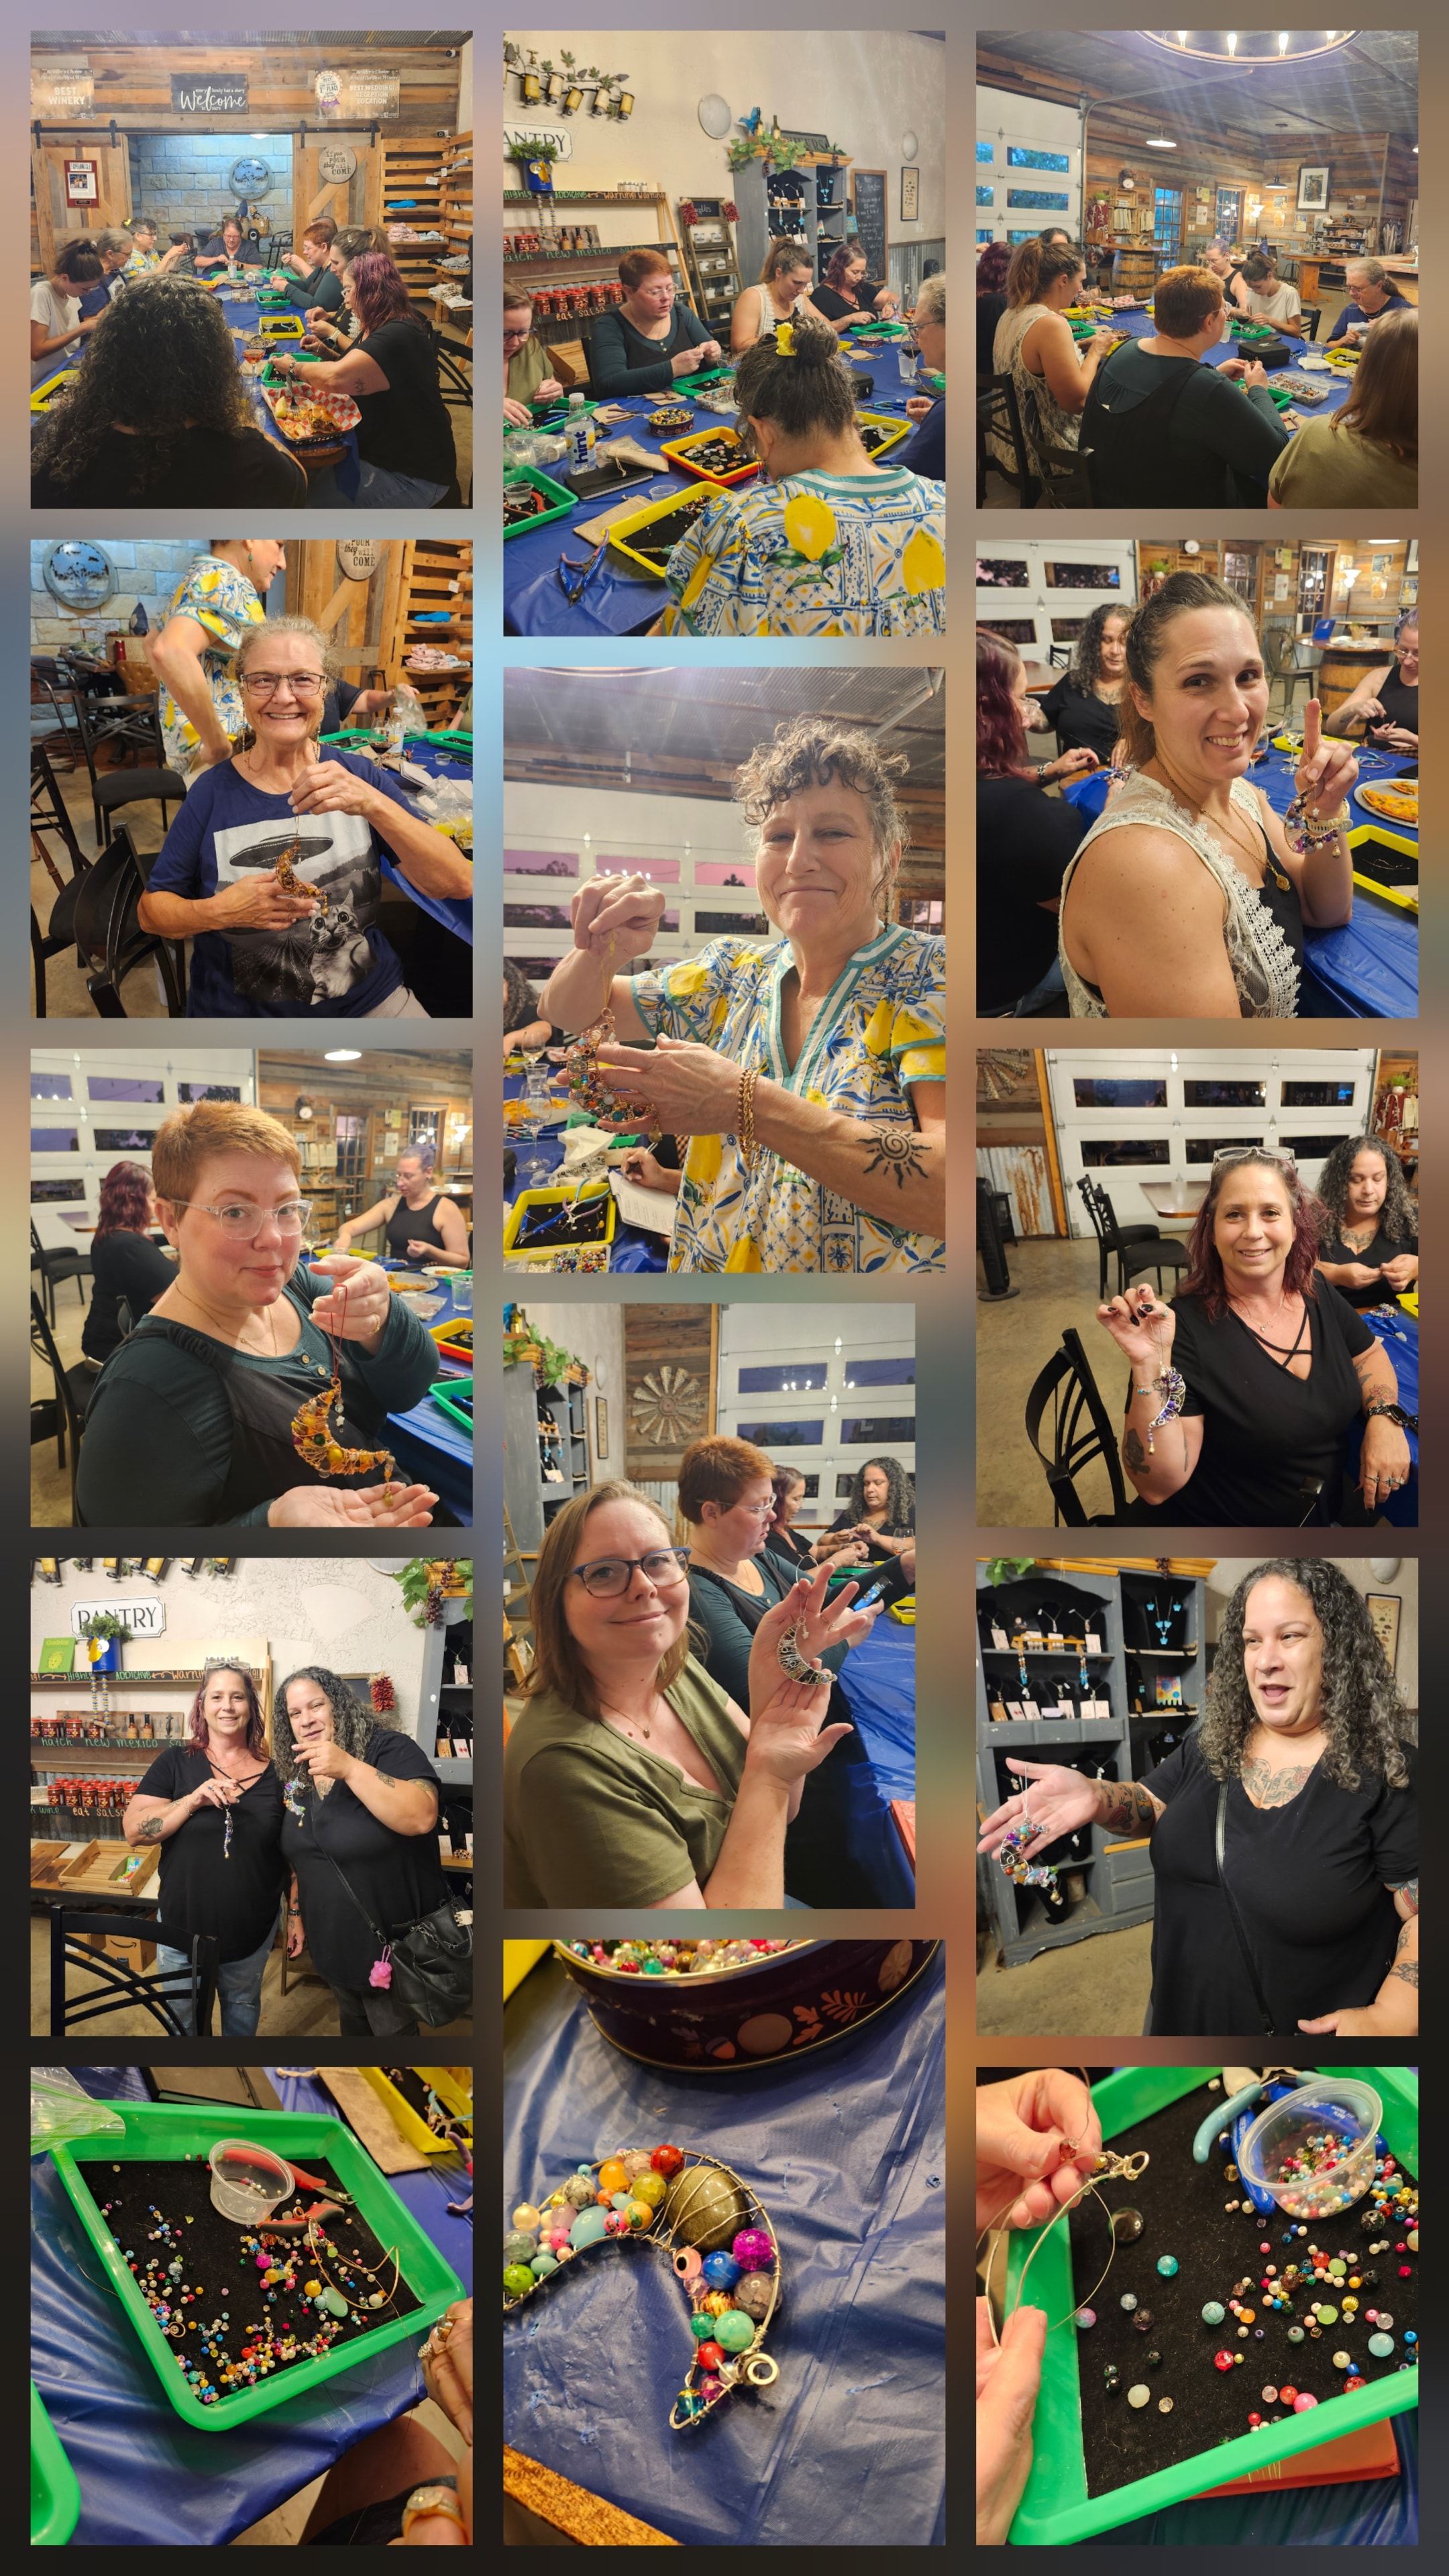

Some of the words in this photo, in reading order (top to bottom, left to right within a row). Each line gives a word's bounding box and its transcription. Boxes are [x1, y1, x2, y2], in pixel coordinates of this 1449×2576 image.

[54, 87, 77, 95] BEST
[48, 96, 85, 105] WINERY
[180, 86, 246, 111] Welcome
[546, 250, 570, 259] new
[576, 248, 612, 257] mexico
[555, 313, 574, 321] eat
[574, 431, 588, 464] hint
[343, 542, 358, 556] they
[358, 547, 374, 556] will
[353, 556, 376, 567] COME
[78, 1607, 156, 1630] PNTRY
[41, 1737, 73, 1747] hatch
[85, 1737, 110, 1748] new
[116, 1739, 158, 1748] mexico
[72, 1807, 90, 1817] eat
